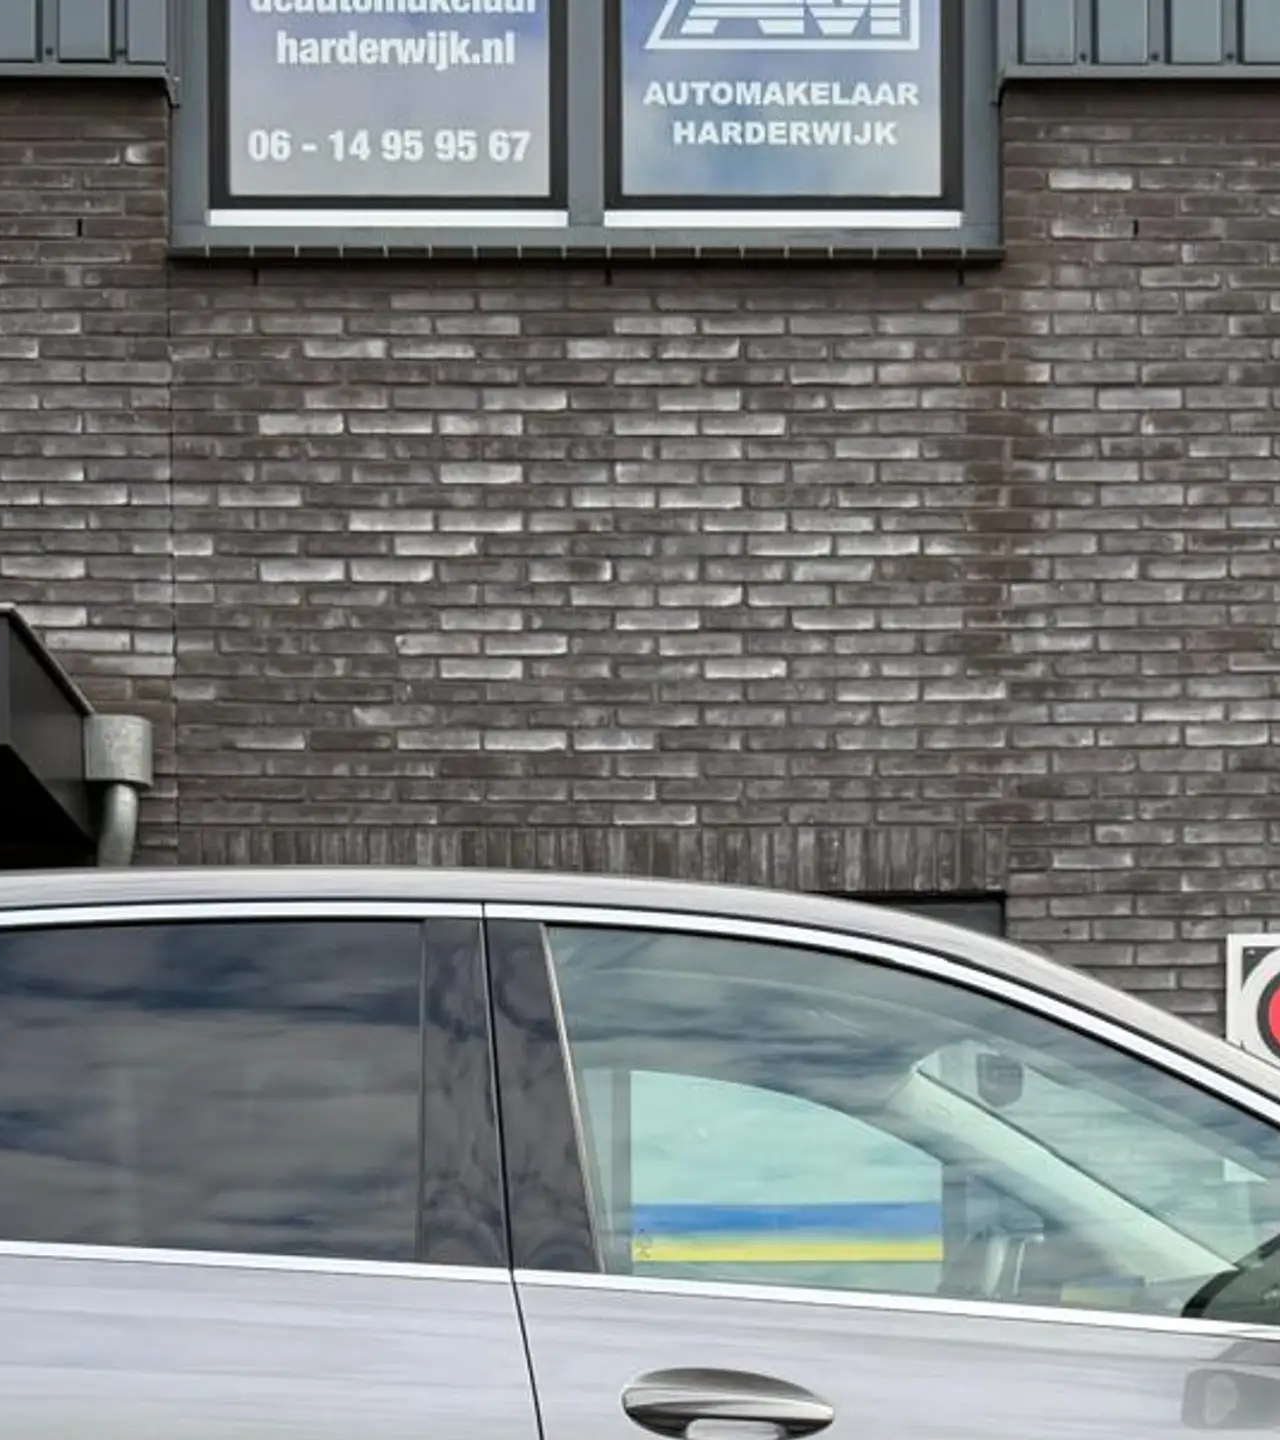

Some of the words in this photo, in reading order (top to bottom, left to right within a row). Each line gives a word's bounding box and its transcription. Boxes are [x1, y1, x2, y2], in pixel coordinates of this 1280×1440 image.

[276, 30, 517, 71] harderwijk.nl
[643, 80, 920, 106] AUTOMAKELAAR
[248, 128, 291, 162] 06
[329, 129, 371, 161] 14
[381, 129, 424, 161] 95
[434, 129, 477, 161] 95
[488, 129, 531, 161] 67
[673, 120, 898, 145] HARDERWIJK
